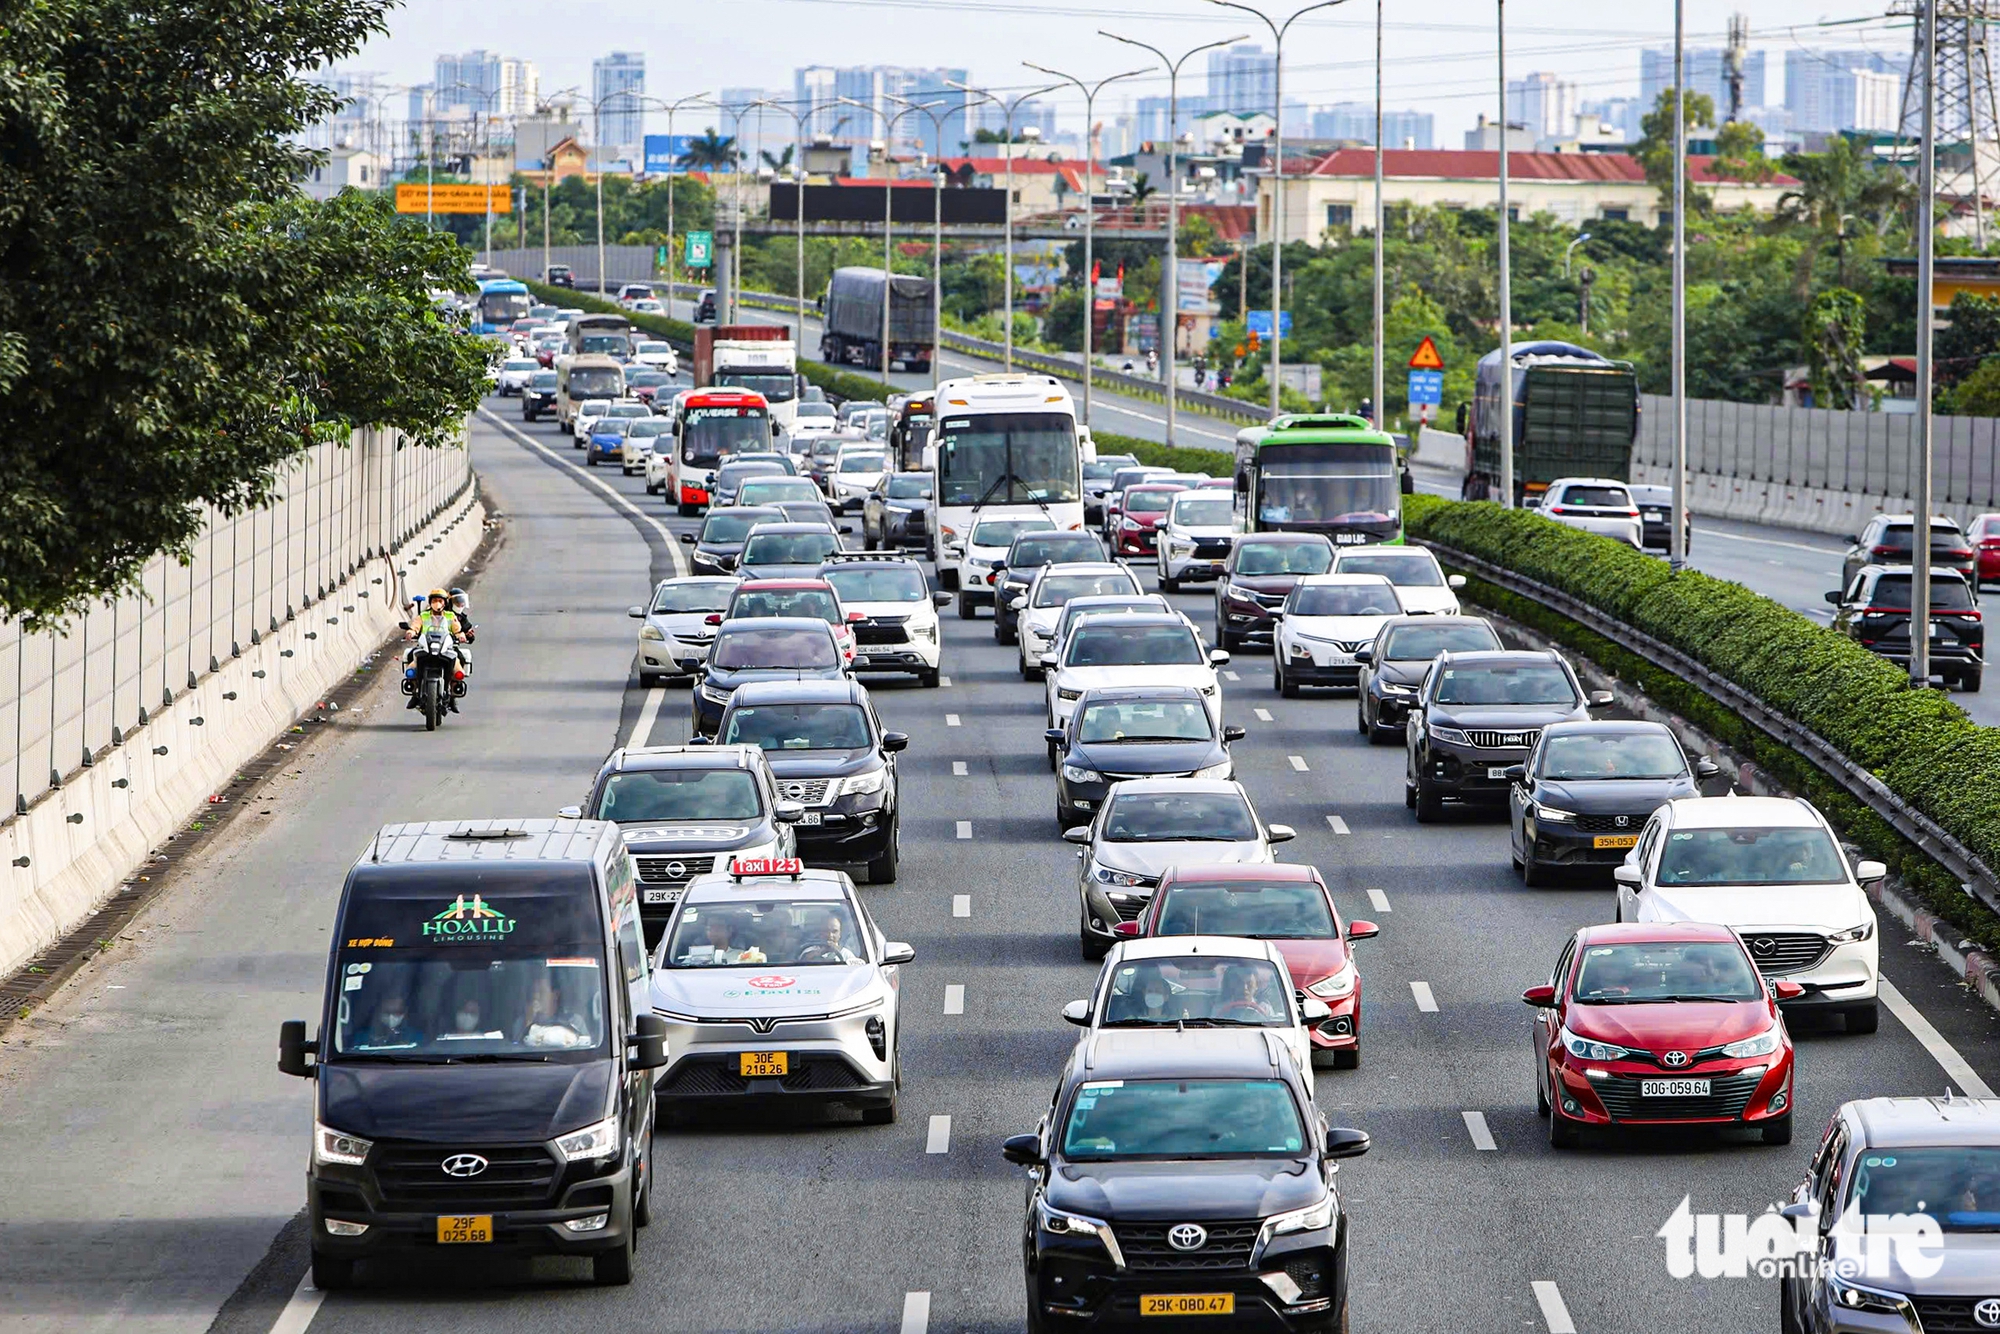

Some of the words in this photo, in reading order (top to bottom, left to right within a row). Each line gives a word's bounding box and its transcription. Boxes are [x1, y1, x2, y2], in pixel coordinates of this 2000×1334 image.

[736, 859, 764, 873] Taxi
[768, 859, 797, 872] 123
[422, 919, 479, 936] HOA
[433, 934, 505, 943] LIMOUSINE
[754, 1053, 774, 1064] 30E
[746, 1064, 783, 1075] 218.26
[1643, 1081, 1709, 1095] 30G-059.64
[453, 1217, 476, 1229] 29F
[443, 1230, 486, 1242] 025.68
[1148, 1297, 1226, 1312] 29K-080.47
